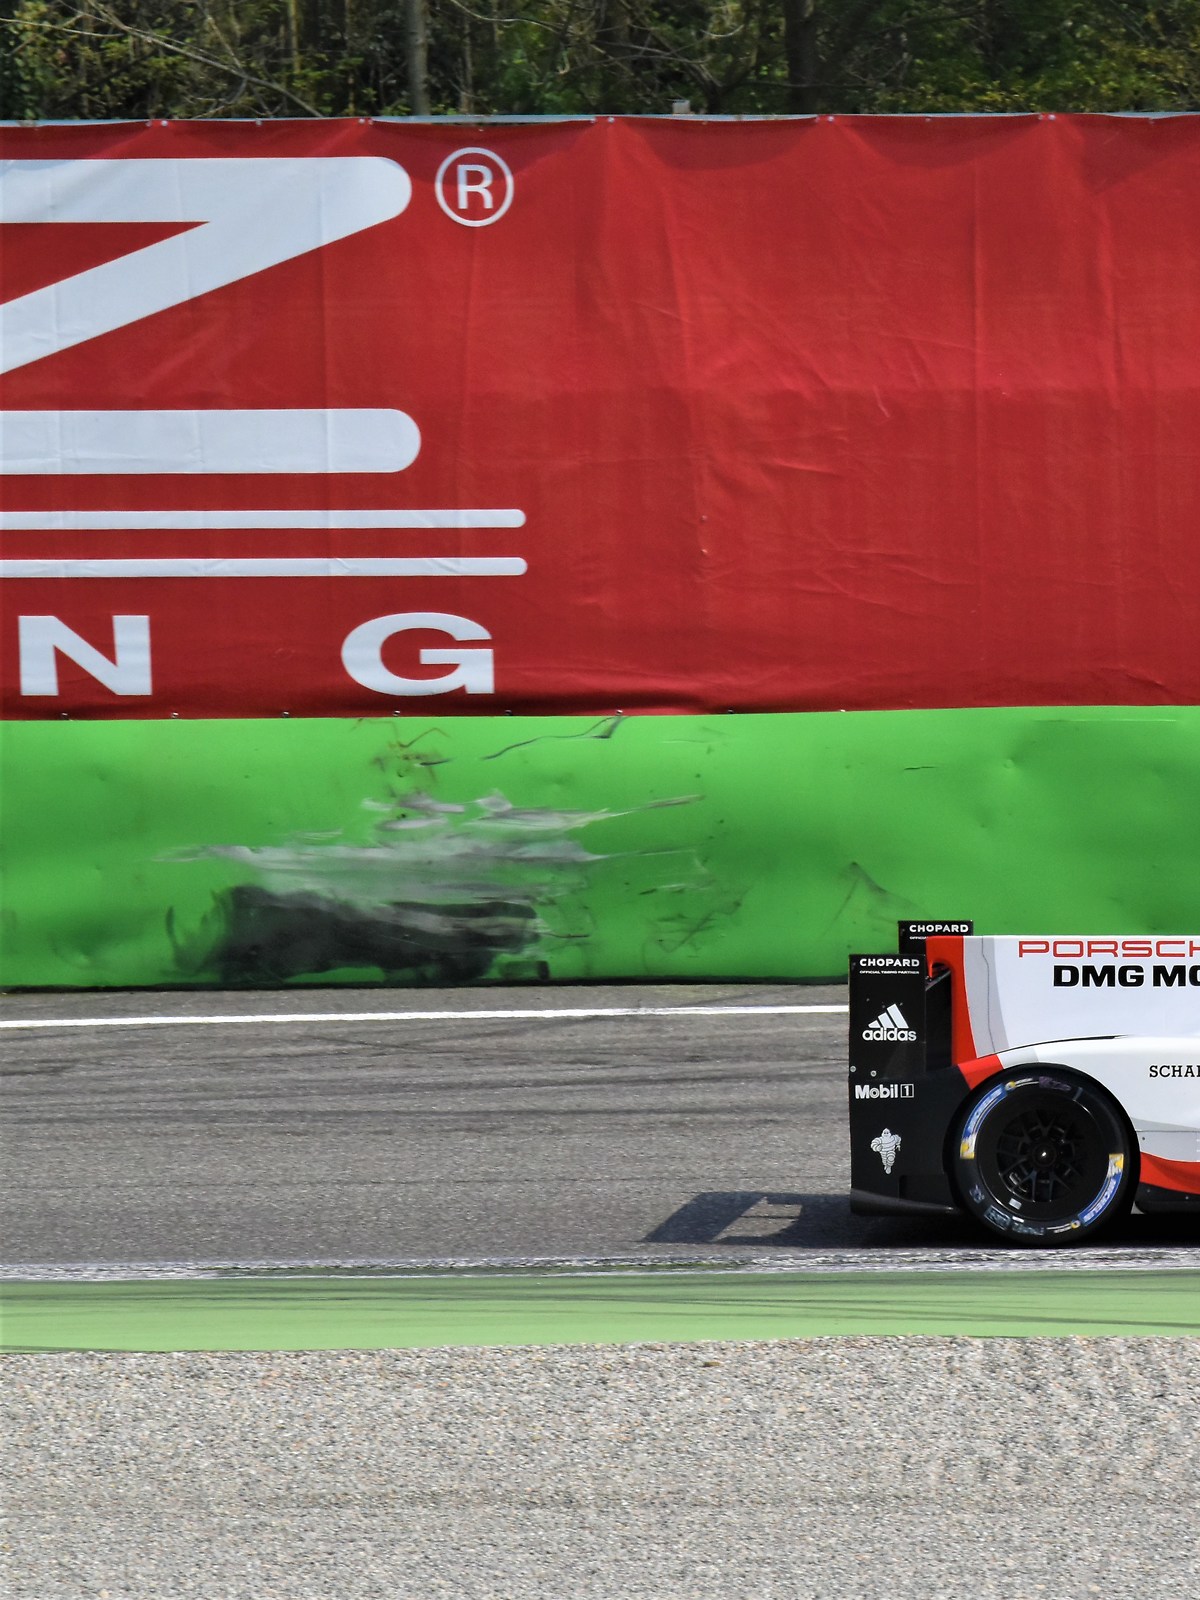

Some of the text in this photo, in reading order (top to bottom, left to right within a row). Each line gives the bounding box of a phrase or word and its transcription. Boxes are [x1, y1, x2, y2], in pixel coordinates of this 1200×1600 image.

[909, 924, 969, 933] CHOPARD
[859, 958, 920, 967] CHOPARD
[1053, 964, 1144, 987] DMG
[862, 1027, 917, 1042] adidas
[855, 1084, 914, 1099] Mobil 1
